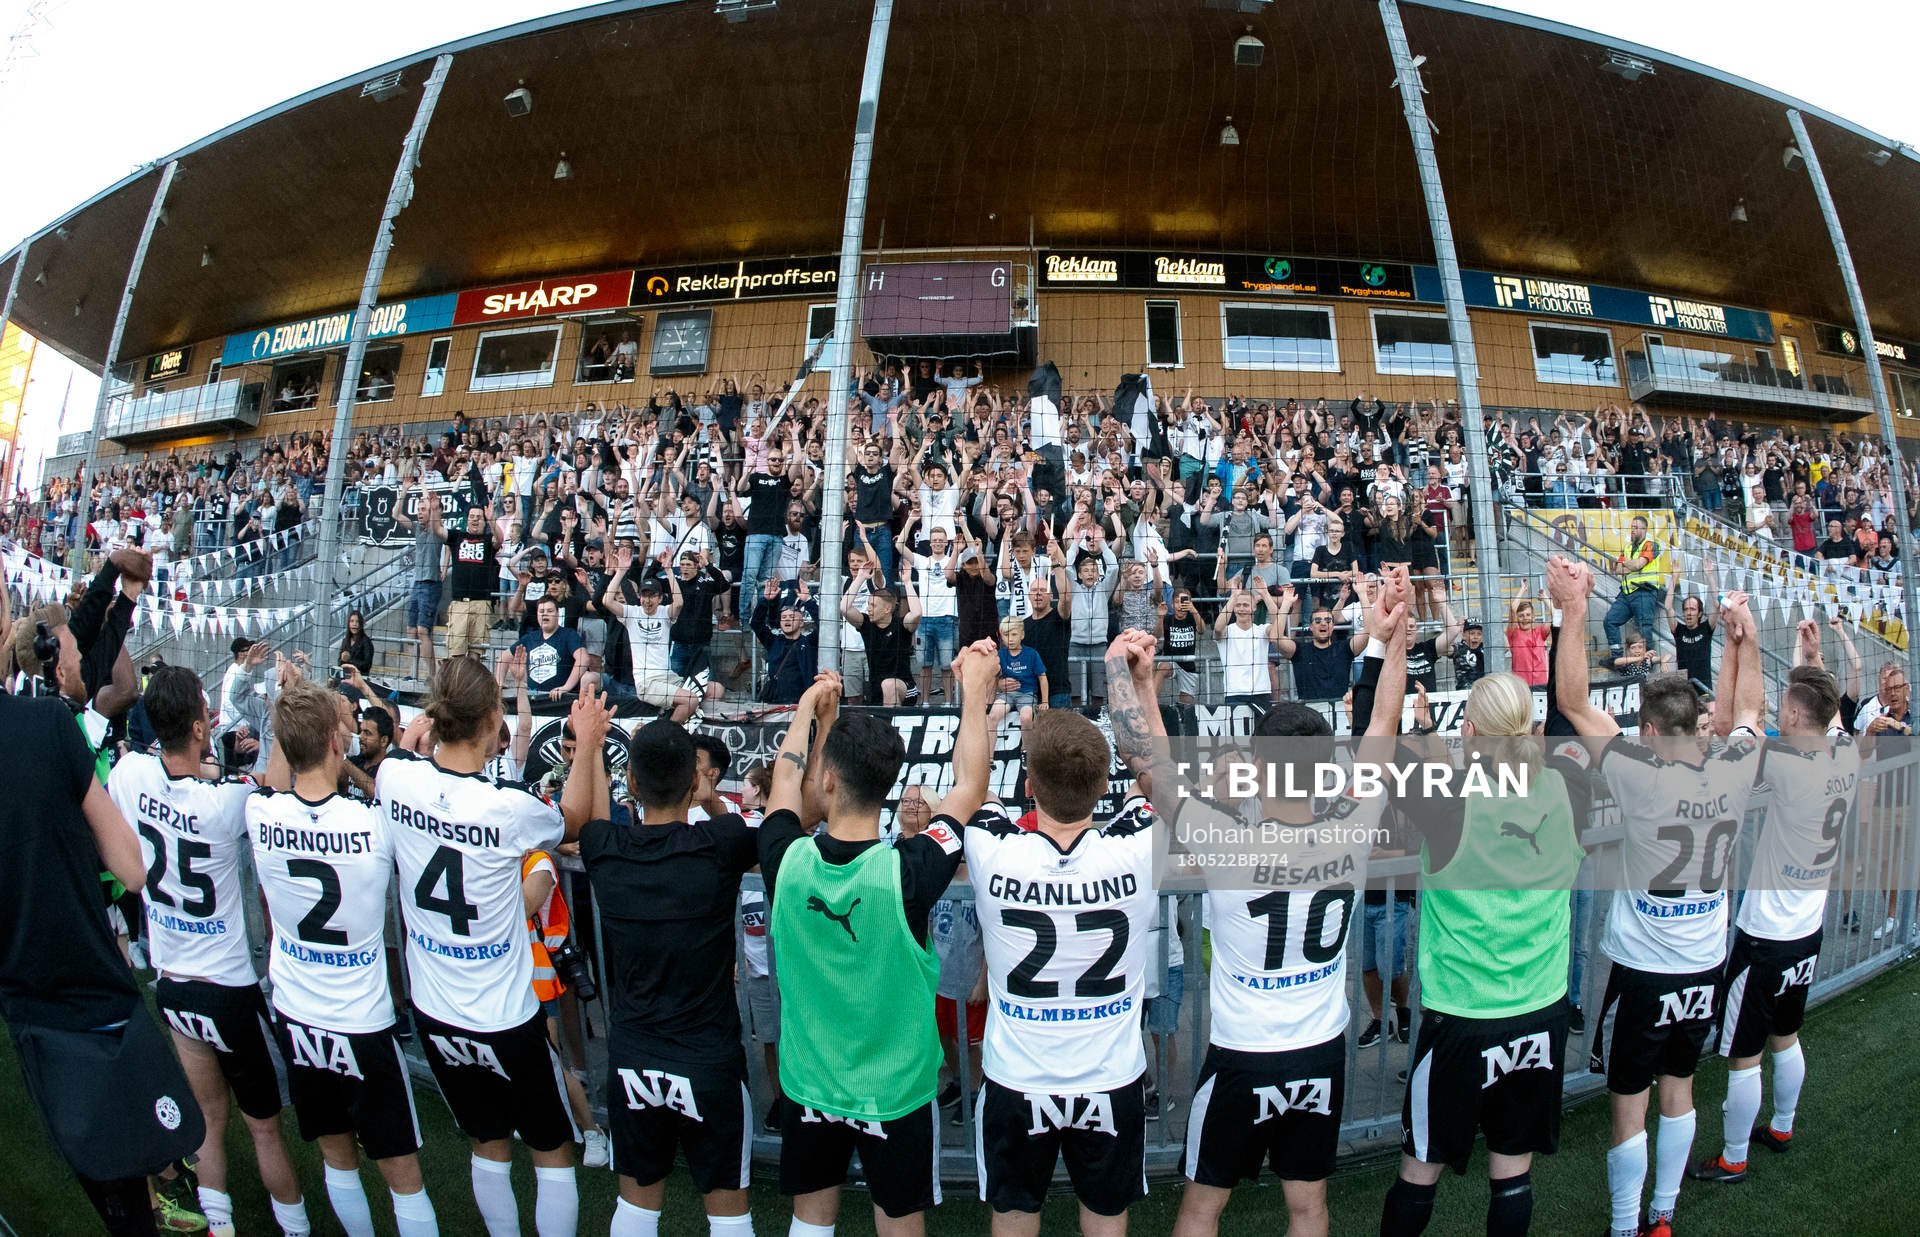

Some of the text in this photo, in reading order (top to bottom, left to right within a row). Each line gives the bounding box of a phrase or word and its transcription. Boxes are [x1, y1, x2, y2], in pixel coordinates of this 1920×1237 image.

[676, 268, 836, 294] Reklamproffsen
[868, 267, 1006, 291] H G
[1046, 255, 1117, 273] Reklam
[1155, 257, 1225, 275] Reklam
[481, 283, 598, 315] SHARP
[1242, 280, 1317, 293] Trygghandel.se
[1341, 286, 1411, 299] Trygghandel.se
[1525, 279, 1590, 302] INDUSTRI
[1674, 299, 1726, 322] INDUSTRI
[1677, 314, 1728, 334] PRODUKTER
[270, 314, 350, 354] EDUCATION
[459, 550, 484, 561] BRO
[139, 792, 200, 835] GERZIC
[391, 800, 500, 848] BRORSSON
[1675, 793, 1729, 820] ROGIC
[260, 822, 372, 856] BJÖRNQUIST
[1812, 797, 1847, 866] 9
[137, 820, 217, 918] 25
[1253, 854, 1355, 886] BESARA
[1648, 819, 1738, 898] 20
[287, 858, 348, 946] 2
[414, 845, 479, 937] 4
[989, 873, 1137, 906] GRANLUND
[1247, 881, 1356, 971] 10
[280, 937, 377, 967] MALMBERGS
[1001, 909, 1130, 998] 22
[1774, 955, 1818, 997] NA
[1000, 996, 1132, 1022] MALMBERGS
[1654, 985, 1714, 1028] NA
[163, 1007, 233, 1053] NA
[286, 1023, 365, 1082] NA
[428, 1034, 511, 1081] NA
[1481, 1031, 1554, 1090] NA
[617, 1068, 703, 1122] NA
[1024, 1093, 1118, 1138] NA
[1253, 1077, 1332, 1126] NA
